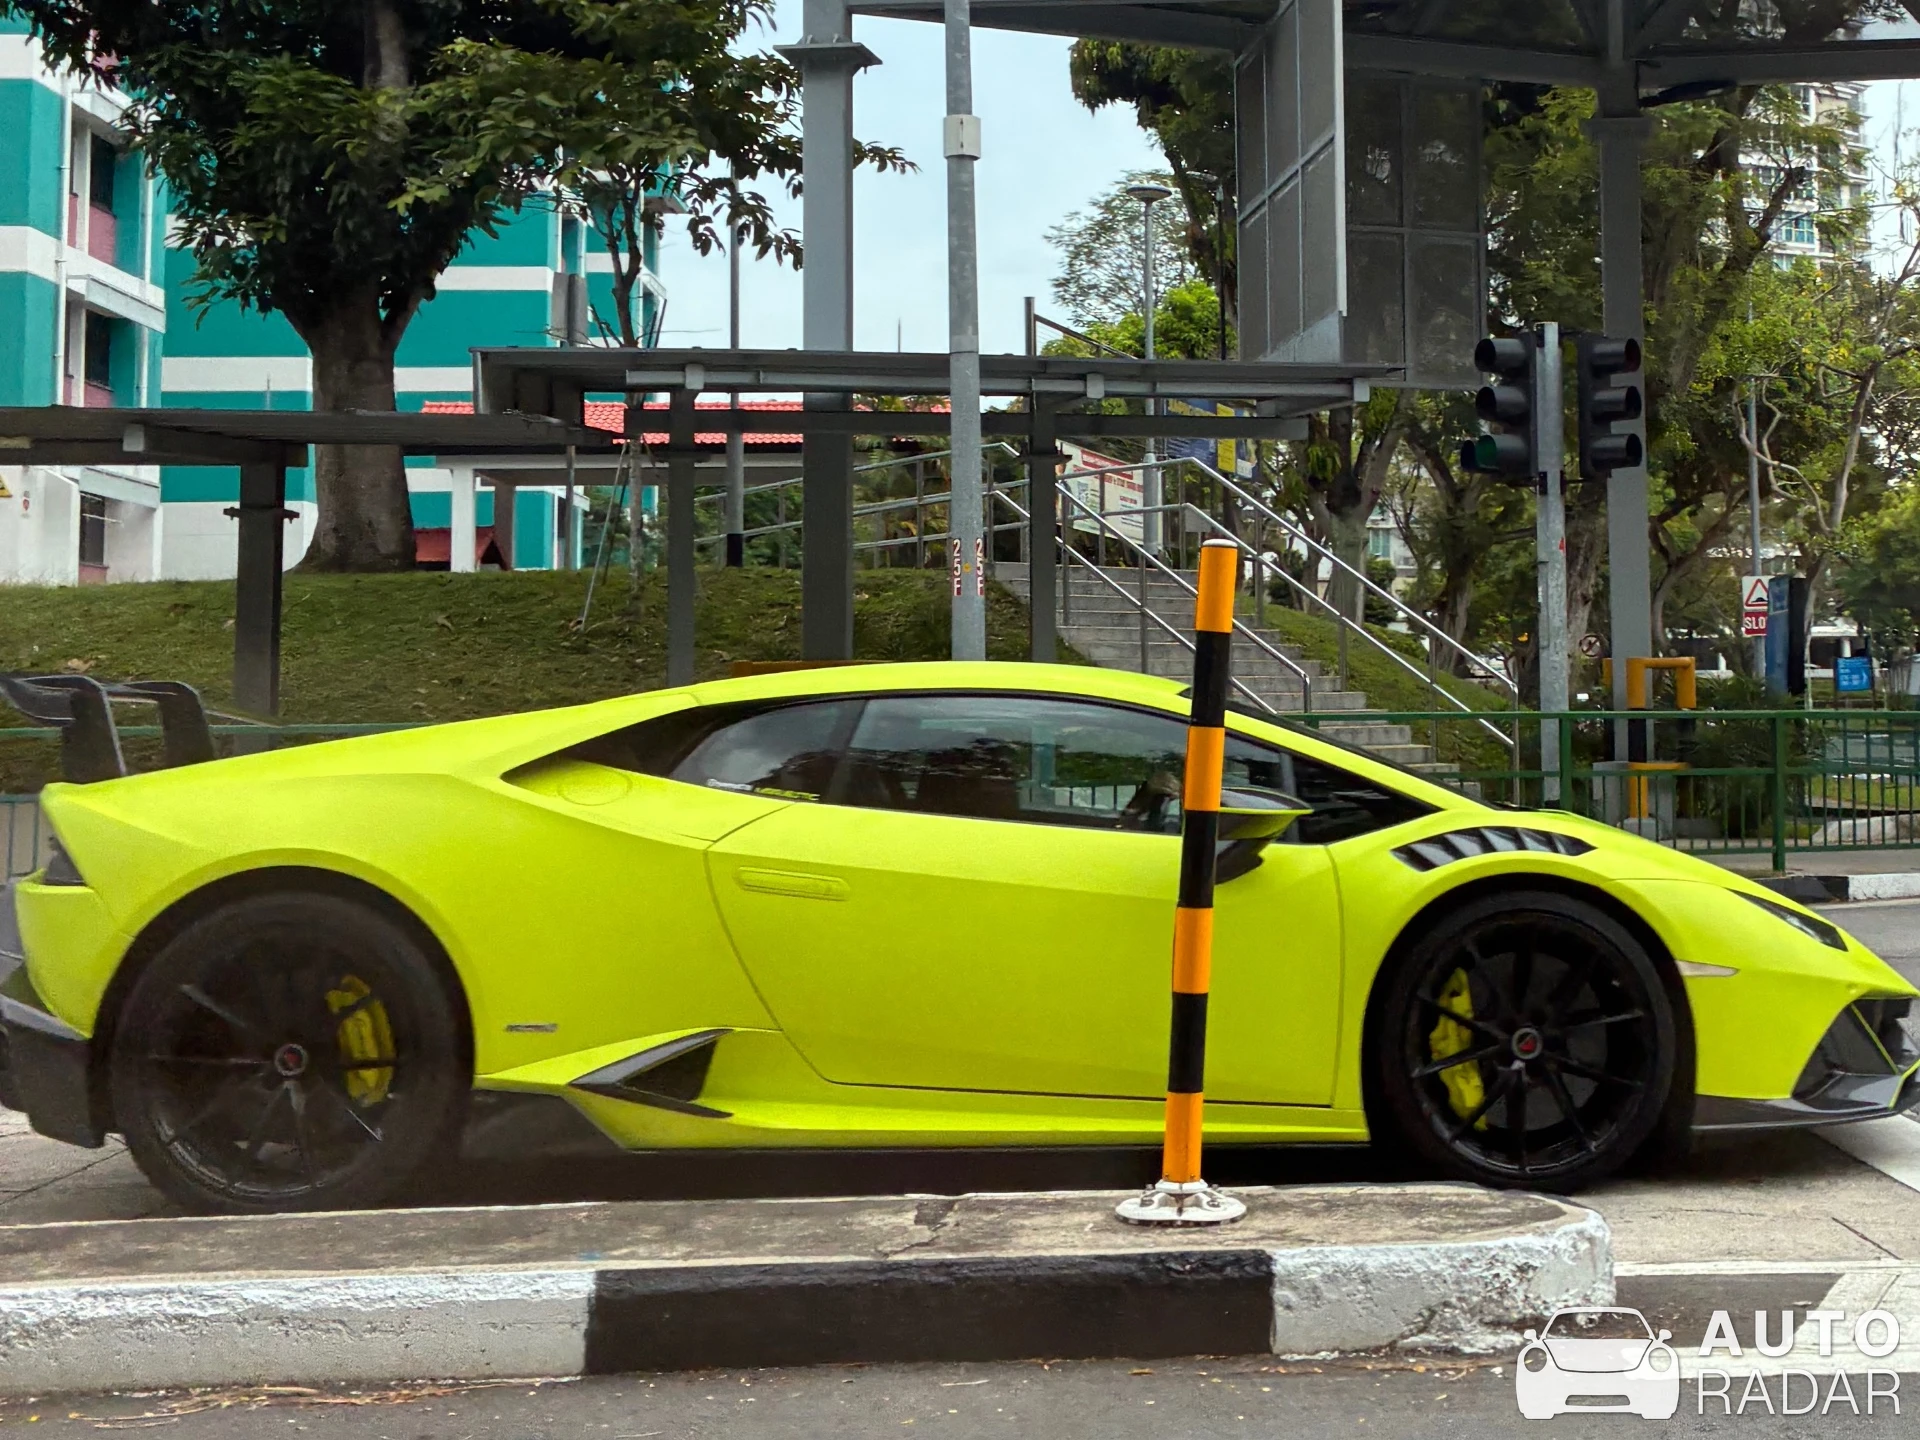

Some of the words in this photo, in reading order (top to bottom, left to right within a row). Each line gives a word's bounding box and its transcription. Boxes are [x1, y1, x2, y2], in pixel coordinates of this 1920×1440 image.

[953, 538, 961, 597] 25F
[976, 538, 984, 597] 25F
[1744, 616, 1768, 630] SLO
